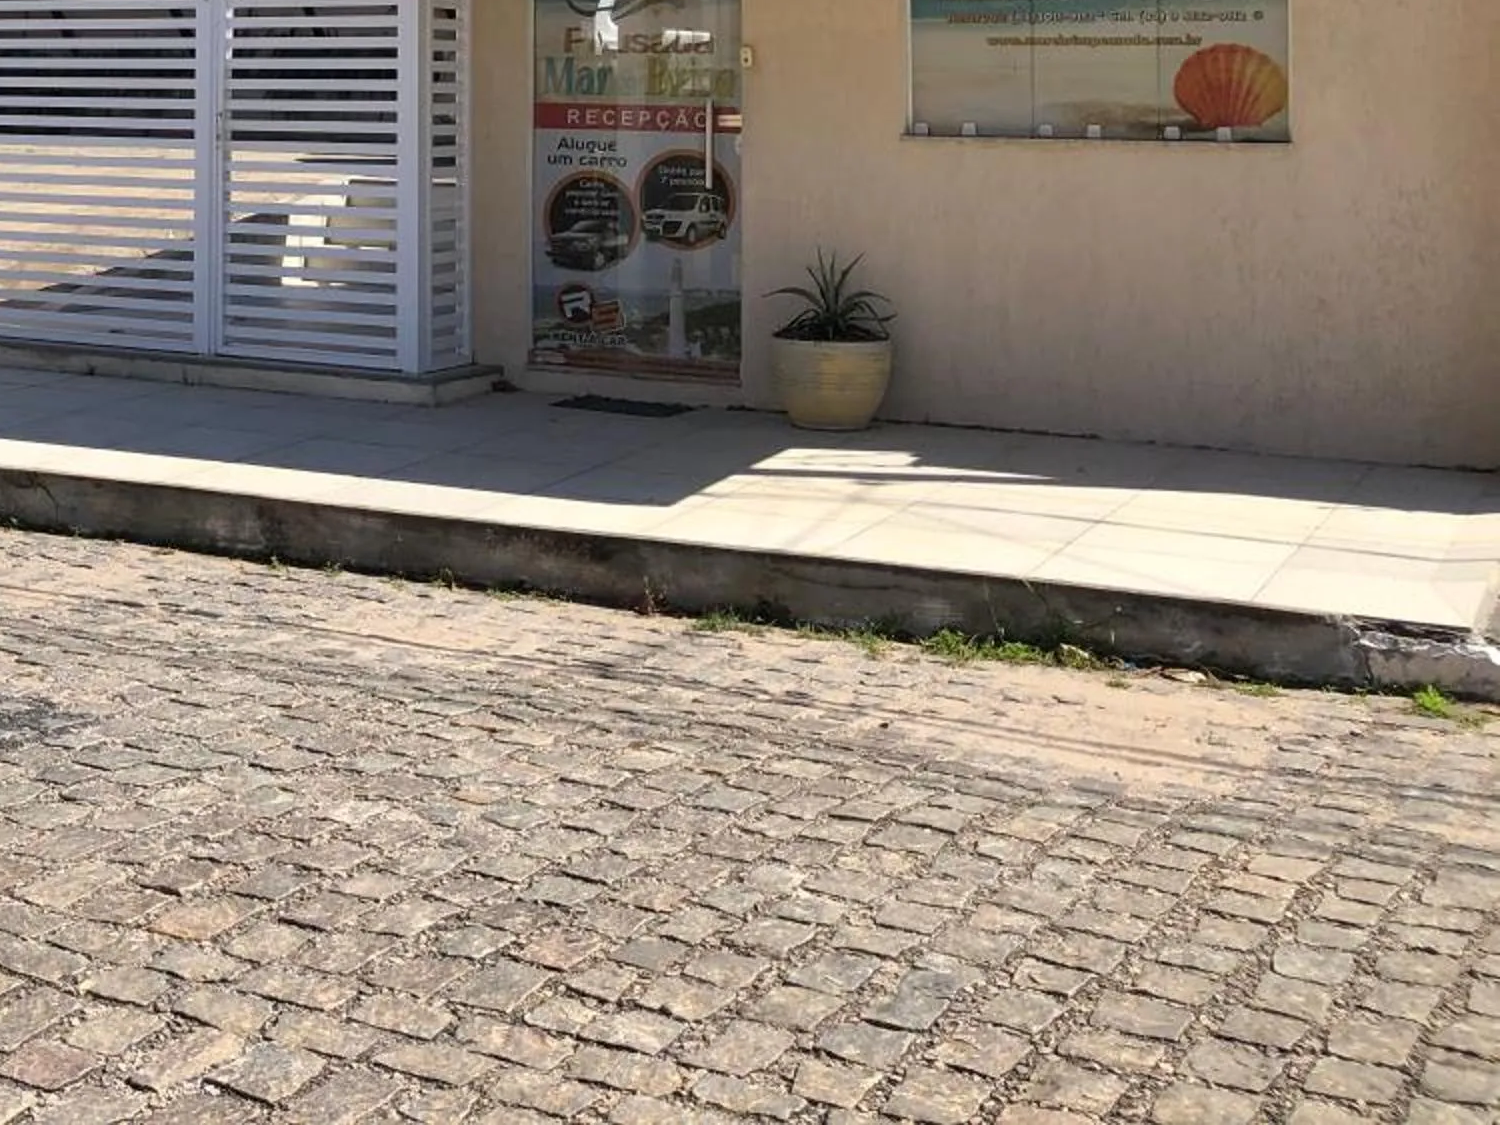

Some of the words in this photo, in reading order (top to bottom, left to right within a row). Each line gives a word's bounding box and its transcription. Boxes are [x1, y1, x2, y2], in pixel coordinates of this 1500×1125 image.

[545, 56, 614, 95] Mar
[556, 136, 618, 154] Alugue
[547, 155, 573, 166] um
[579, 155, 628, 168] carro
